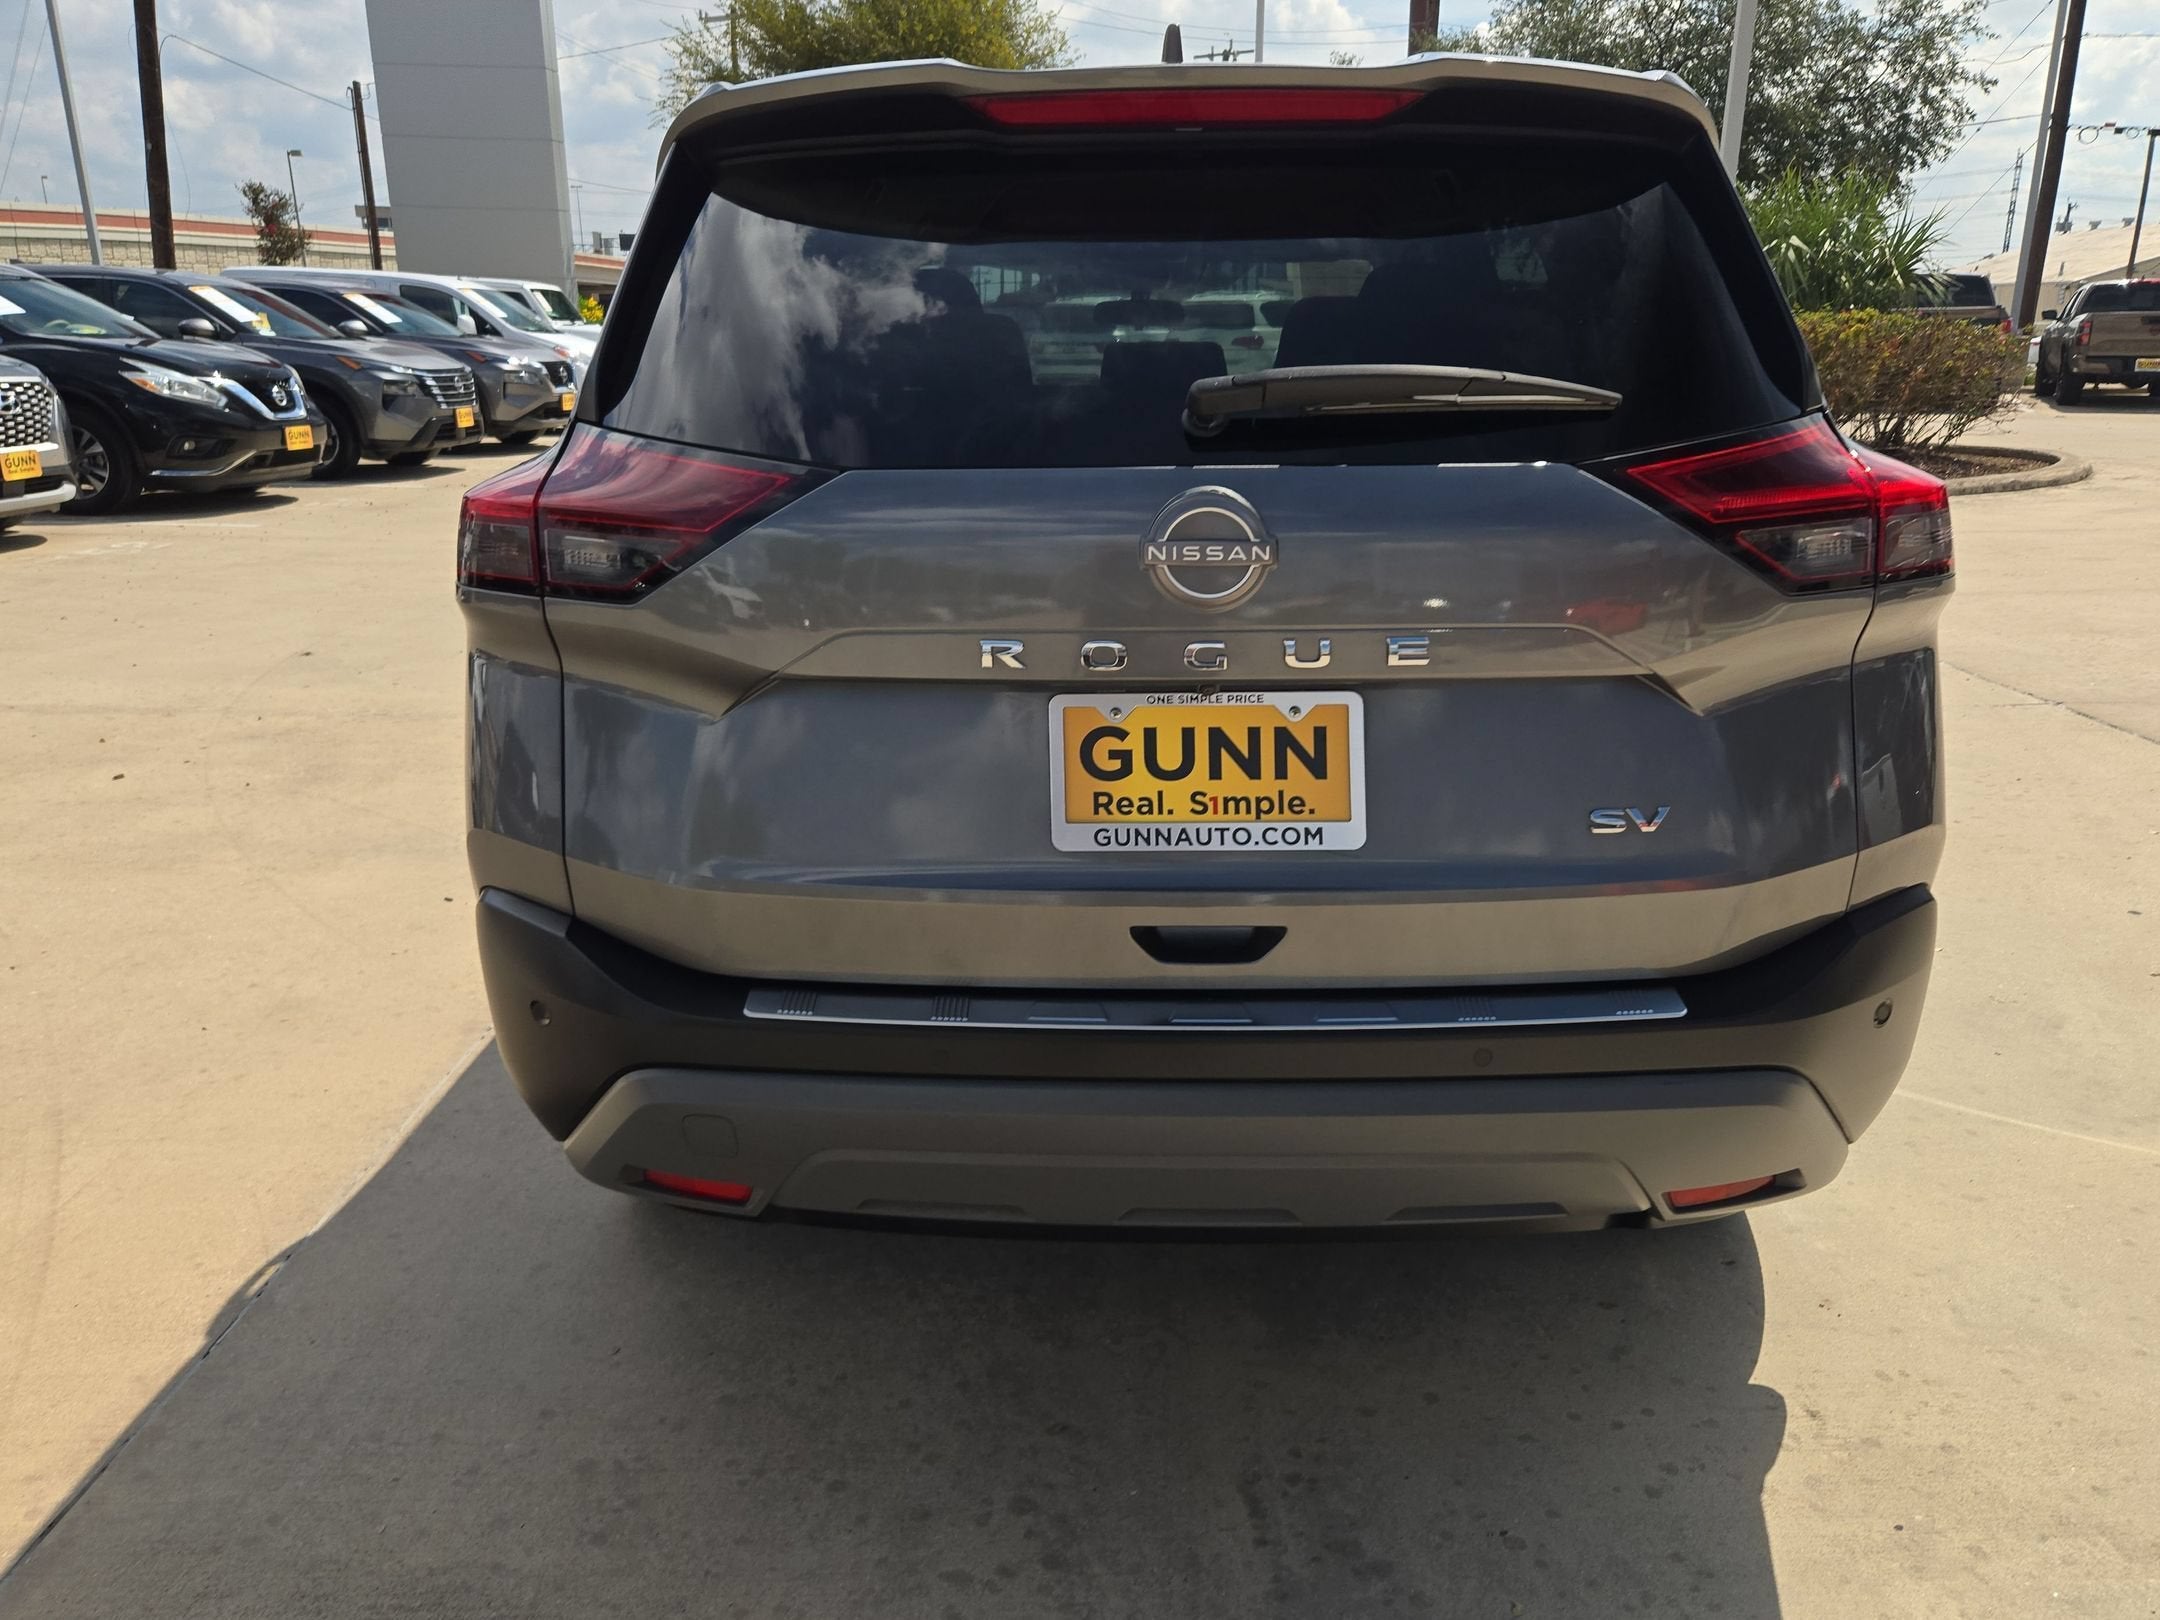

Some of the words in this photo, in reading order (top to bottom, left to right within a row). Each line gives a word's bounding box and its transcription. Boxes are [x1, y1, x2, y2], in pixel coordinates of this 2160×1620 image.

[4, 454, 37, 469] GUNN
[1147, 544, 1272, 562] NISSAN
[979, 636, 1431, 672] ROGUE
[1145, 694, 1174, 705] ONE
[1177, 694, 1223, 705] SIMPLE
[1226, 693, 1265, 704] PRICE
[1079, 726, 1328, 782] GUNN
[1092, 790, 1174, 816] Real.
[1189, 790, 1316, 820] S1mple.
[1589, 806, 1671, 834] SV
[1093, 826, 1324, 847] GUNNAUTO.COM
